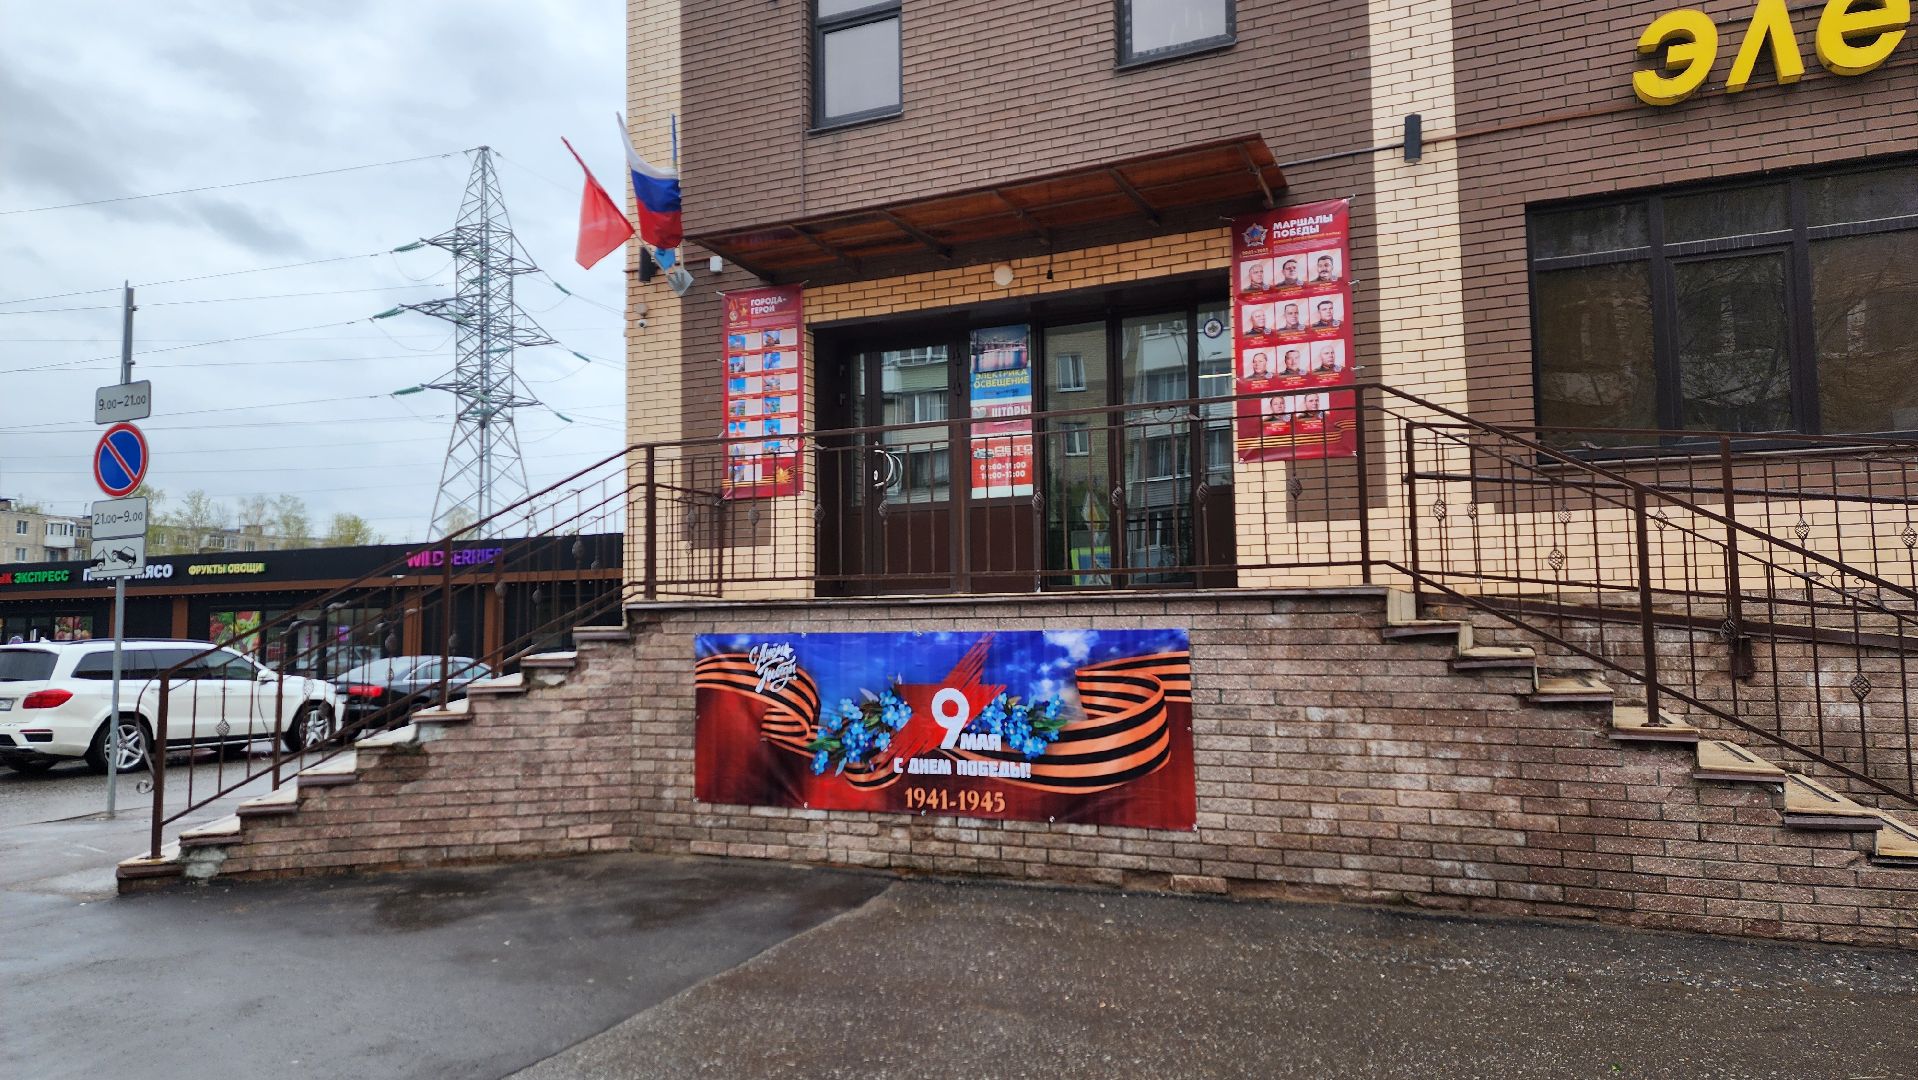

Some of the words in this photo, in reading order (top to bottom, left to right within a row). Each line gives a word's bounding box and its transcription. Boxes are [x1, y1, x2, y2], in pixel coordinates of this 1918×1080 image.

[1273, 214, 1333, 231] МАРШАЛЫ
[1273, 224, 1319, 239] ПОБЕДЫ
[750, 305, 775, 315] ГЕРОИ
[975, 369, 1027, 380] ЭЛЕКТРИКА
[973, 376, 1029, 388] ОСВЕЩЕНИЕ
[992, 405, 1031, 418] ШТОРЫ
[188, 564, 226, 576] ФРУКТЫ
[227, 563, 265, 574] ОВОЩИ
[14, 570, 69, 584] ЭКСПРЕСС
[931, 687, 970, 750] 9
[960, 733, 1001, 752] МАЯ
[893, 757, 904, 774] С
[907, 758, 952, 776] ДНЕМ
[956, 759, 1032, 779] ПОБЕДЫ!
[905, 787, 1006, 813] 1941-1945
